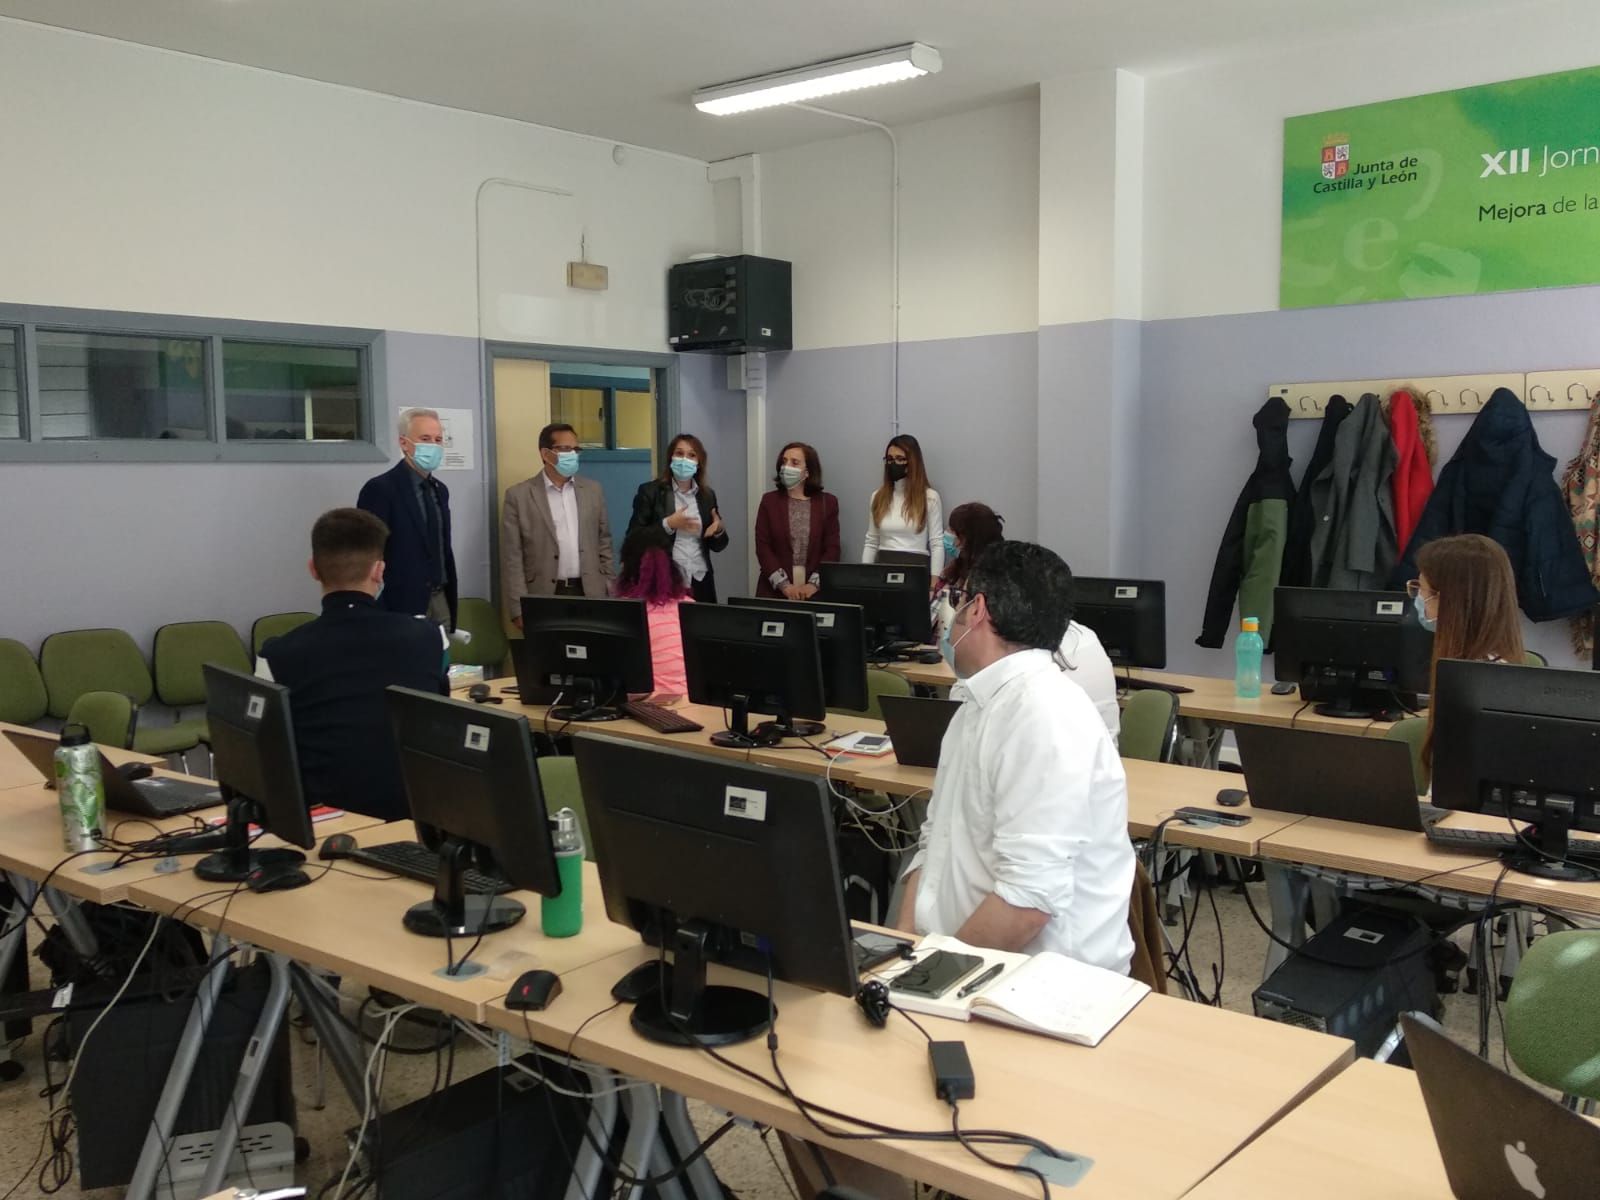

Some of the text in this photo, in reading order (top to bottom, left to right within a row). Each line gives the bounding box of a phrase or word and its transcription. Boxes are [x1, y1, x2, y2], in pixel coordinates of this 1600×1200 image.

[1353, 156, 1418, 175] Junta de
[1480, 147, 1530, 178] XII
[1313, 170, 1417, 194] Castilla y León
[1479, 193, 1599, 223] Mejora de la
